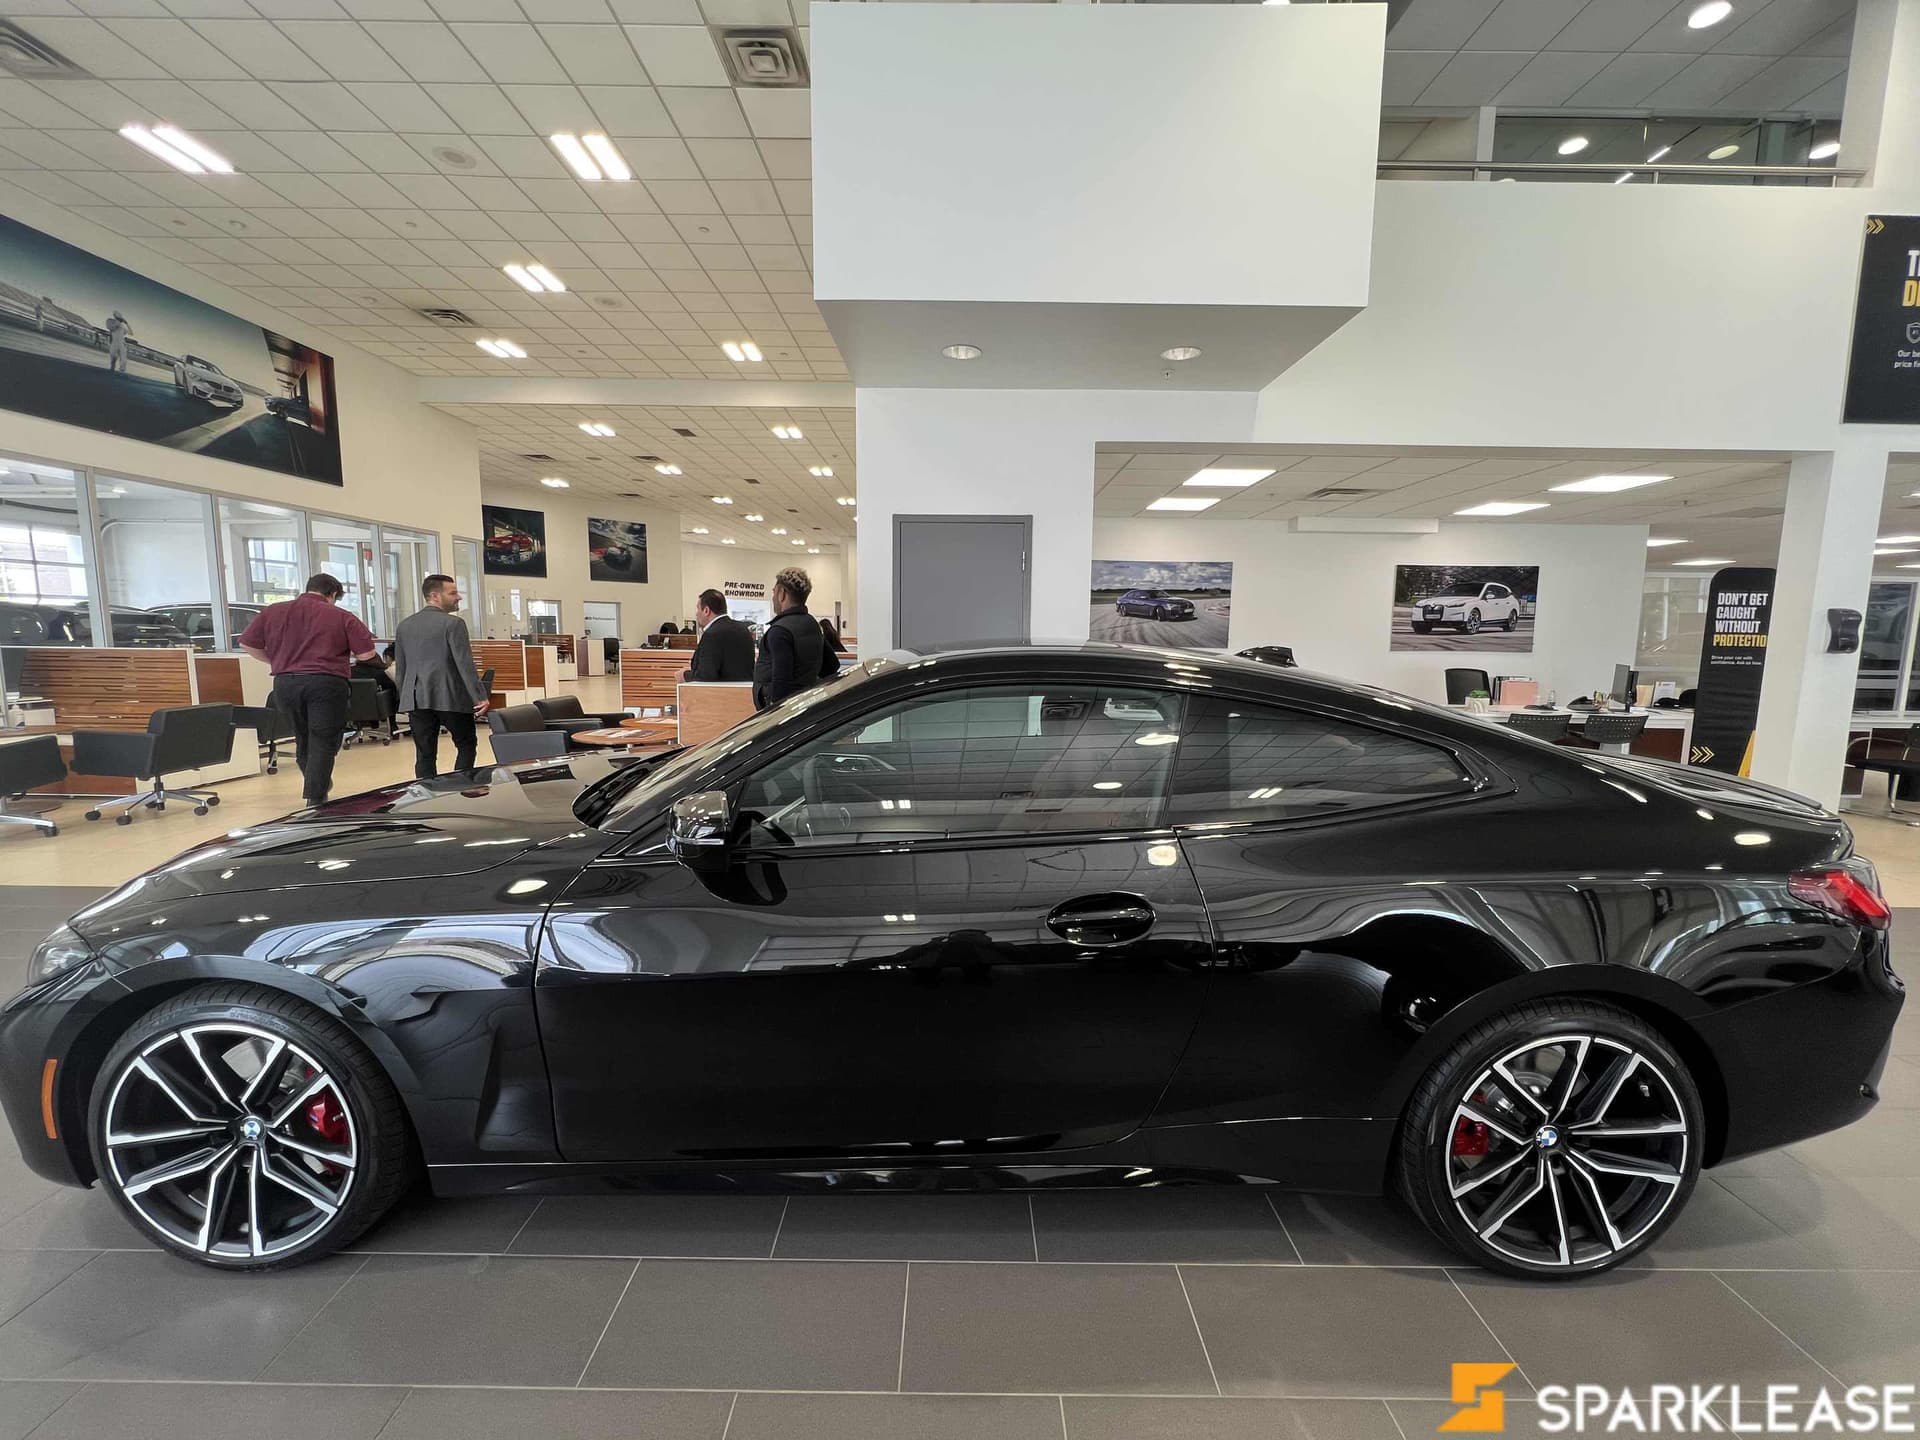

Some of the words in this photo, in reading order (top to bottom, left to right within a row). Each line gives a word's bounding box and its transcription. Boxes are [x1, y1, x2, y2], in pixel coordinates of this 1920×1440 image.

[724, 581, 765, 590] PRE-OWNED
[724, 589, 765, 598] SHOWROOM
[1717, 592, 1748, 605] DON'T
[1749, 593, 1768, 606] GET
[1716, 606, 1757, 619] CAUGHT
[1715, 620, 1761, 633] WITHOUT
[1713, 634, 1767, 647] PROTECTIO
